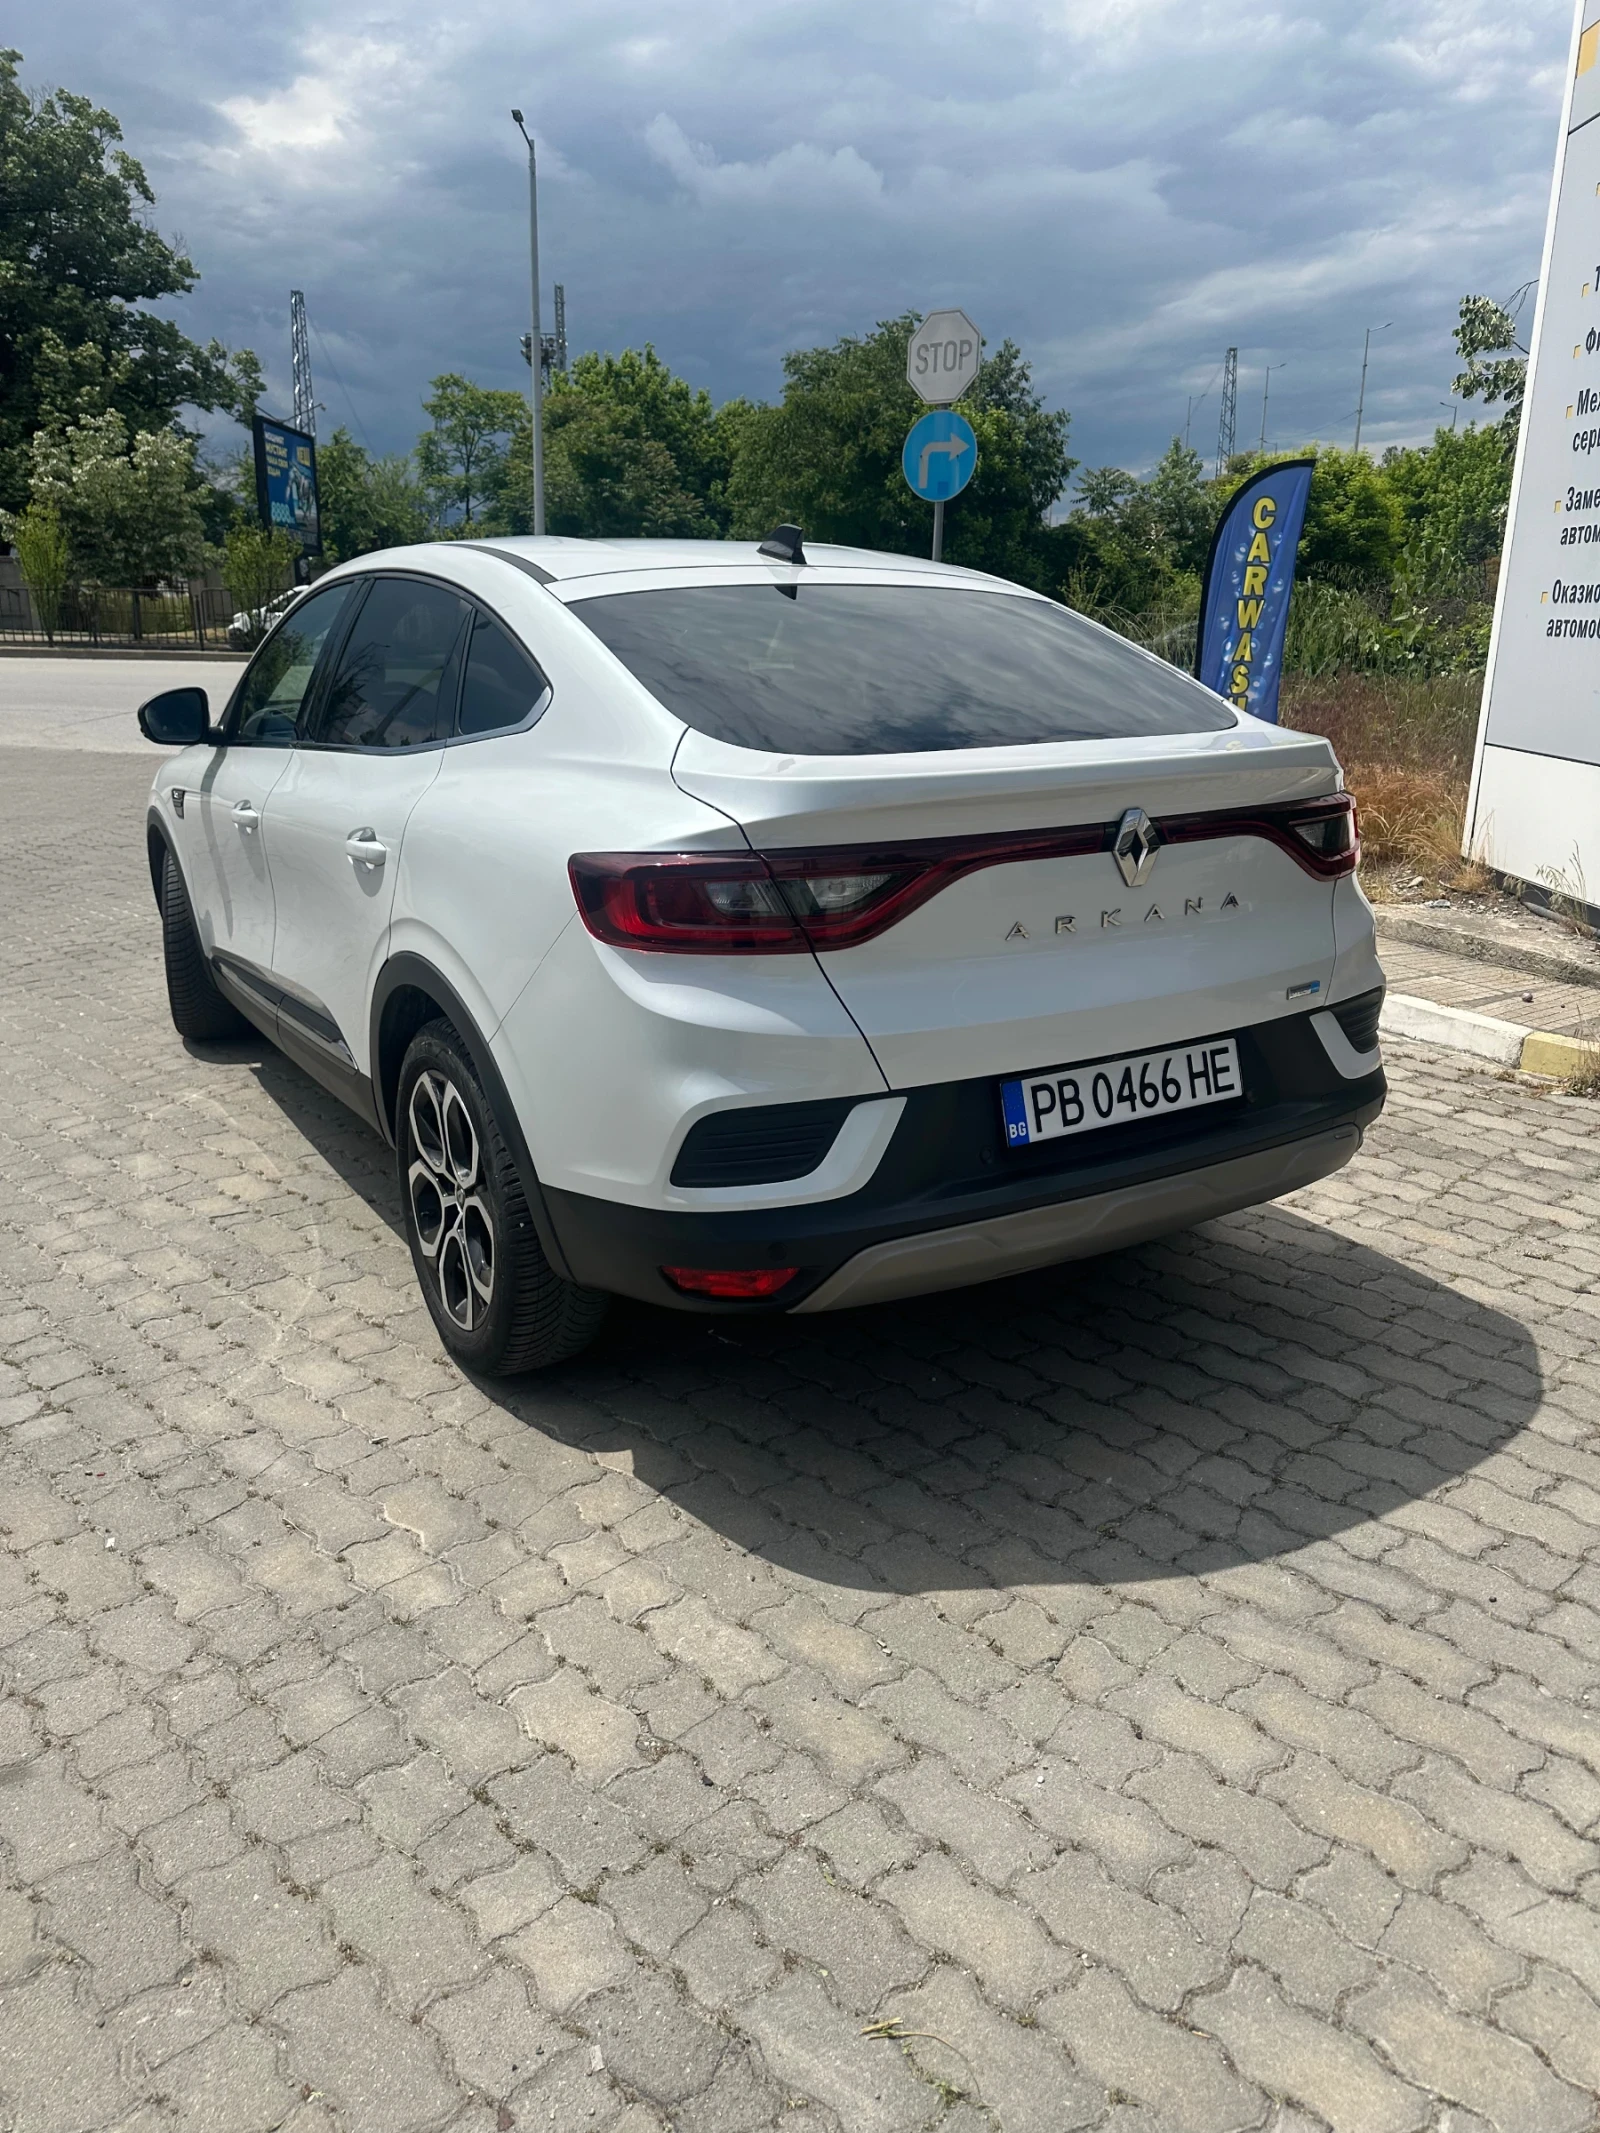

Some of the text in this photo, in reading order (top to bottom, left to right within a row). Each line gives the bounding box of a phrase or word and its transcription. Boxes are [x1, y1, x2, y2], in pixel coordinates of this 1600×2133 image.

[915, 340, 973, 375] STOP
[1565, 486, 1600, 512] Заме
[1005, 891, 1240, 941] ARKANA
[1030, 1046, 1235, 1134] PB 0466 HE
[1008, 1121, 1027, 1140] BG
